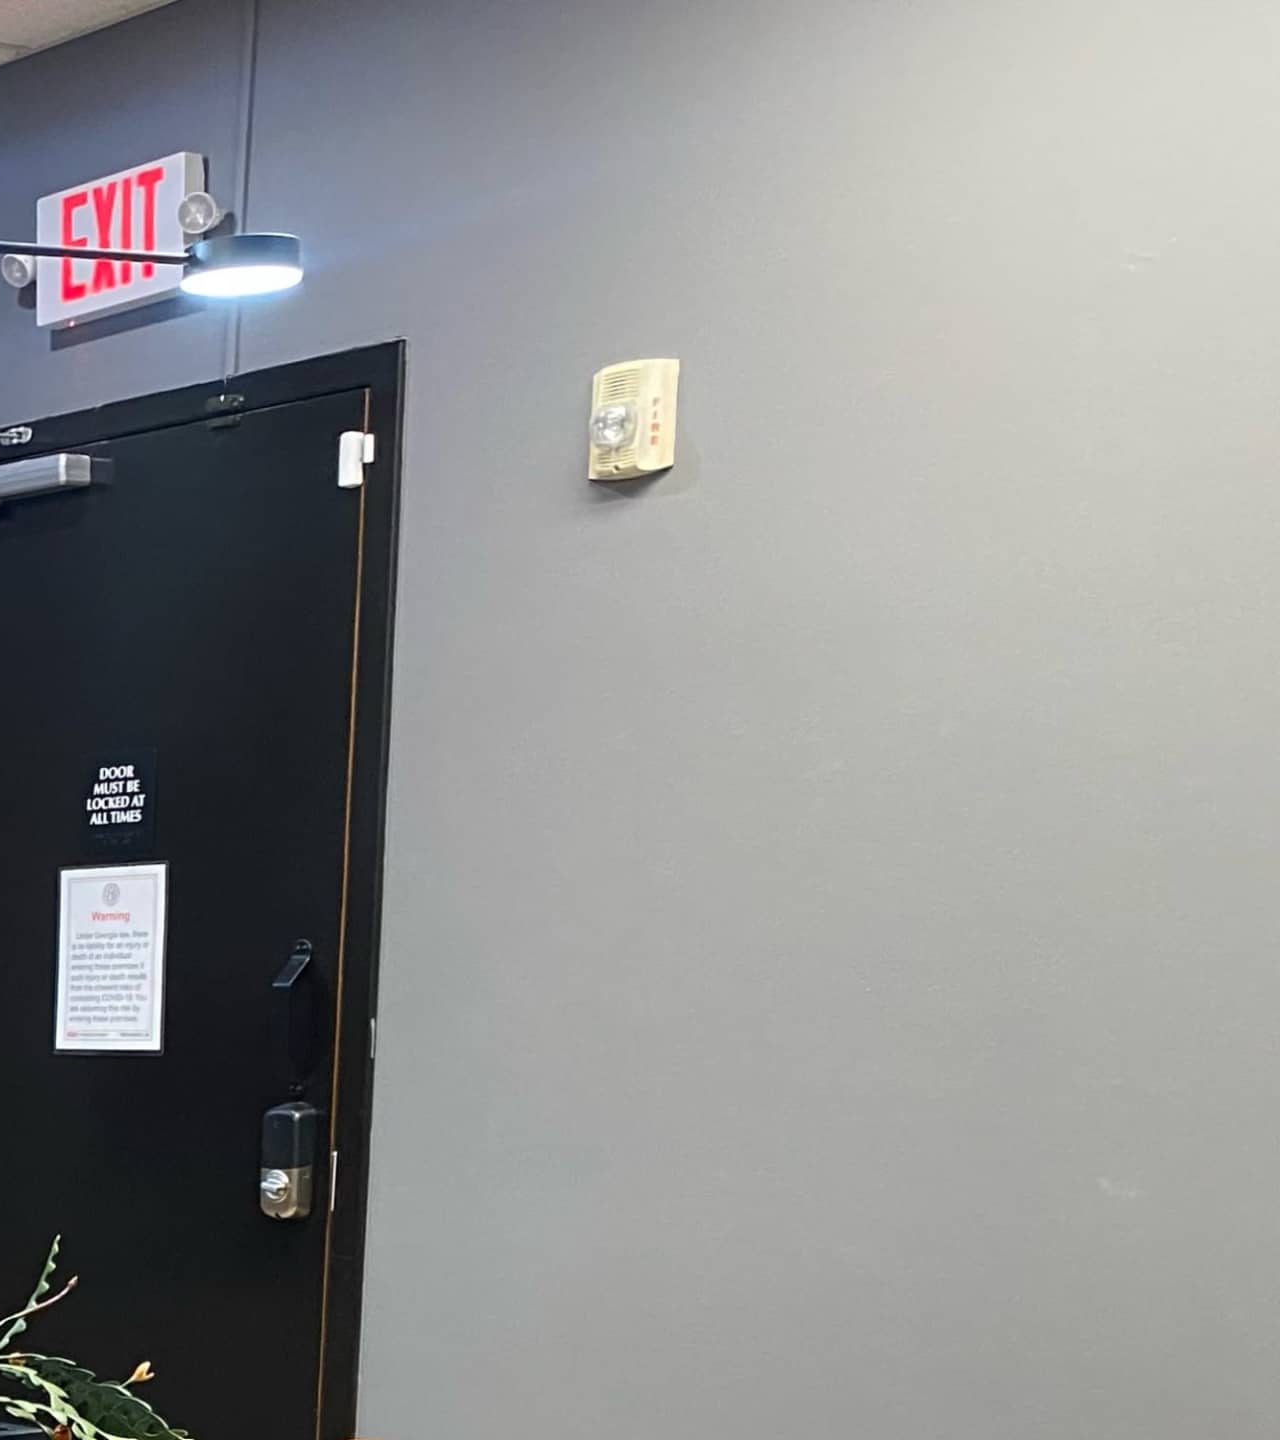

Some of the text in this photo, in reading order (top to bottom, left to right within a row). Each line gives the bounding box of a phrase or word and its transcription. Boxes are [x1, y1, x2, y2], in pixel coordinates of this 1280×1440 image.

[60, 166, 165, 304] EXIT
[99, 765, 135, 780] DOOR
[93, 779, 141, 795] MUST BE
[86, 794, 146, 811] LOCKED AT
[89, 809, 142, 825] ALL TIMES
